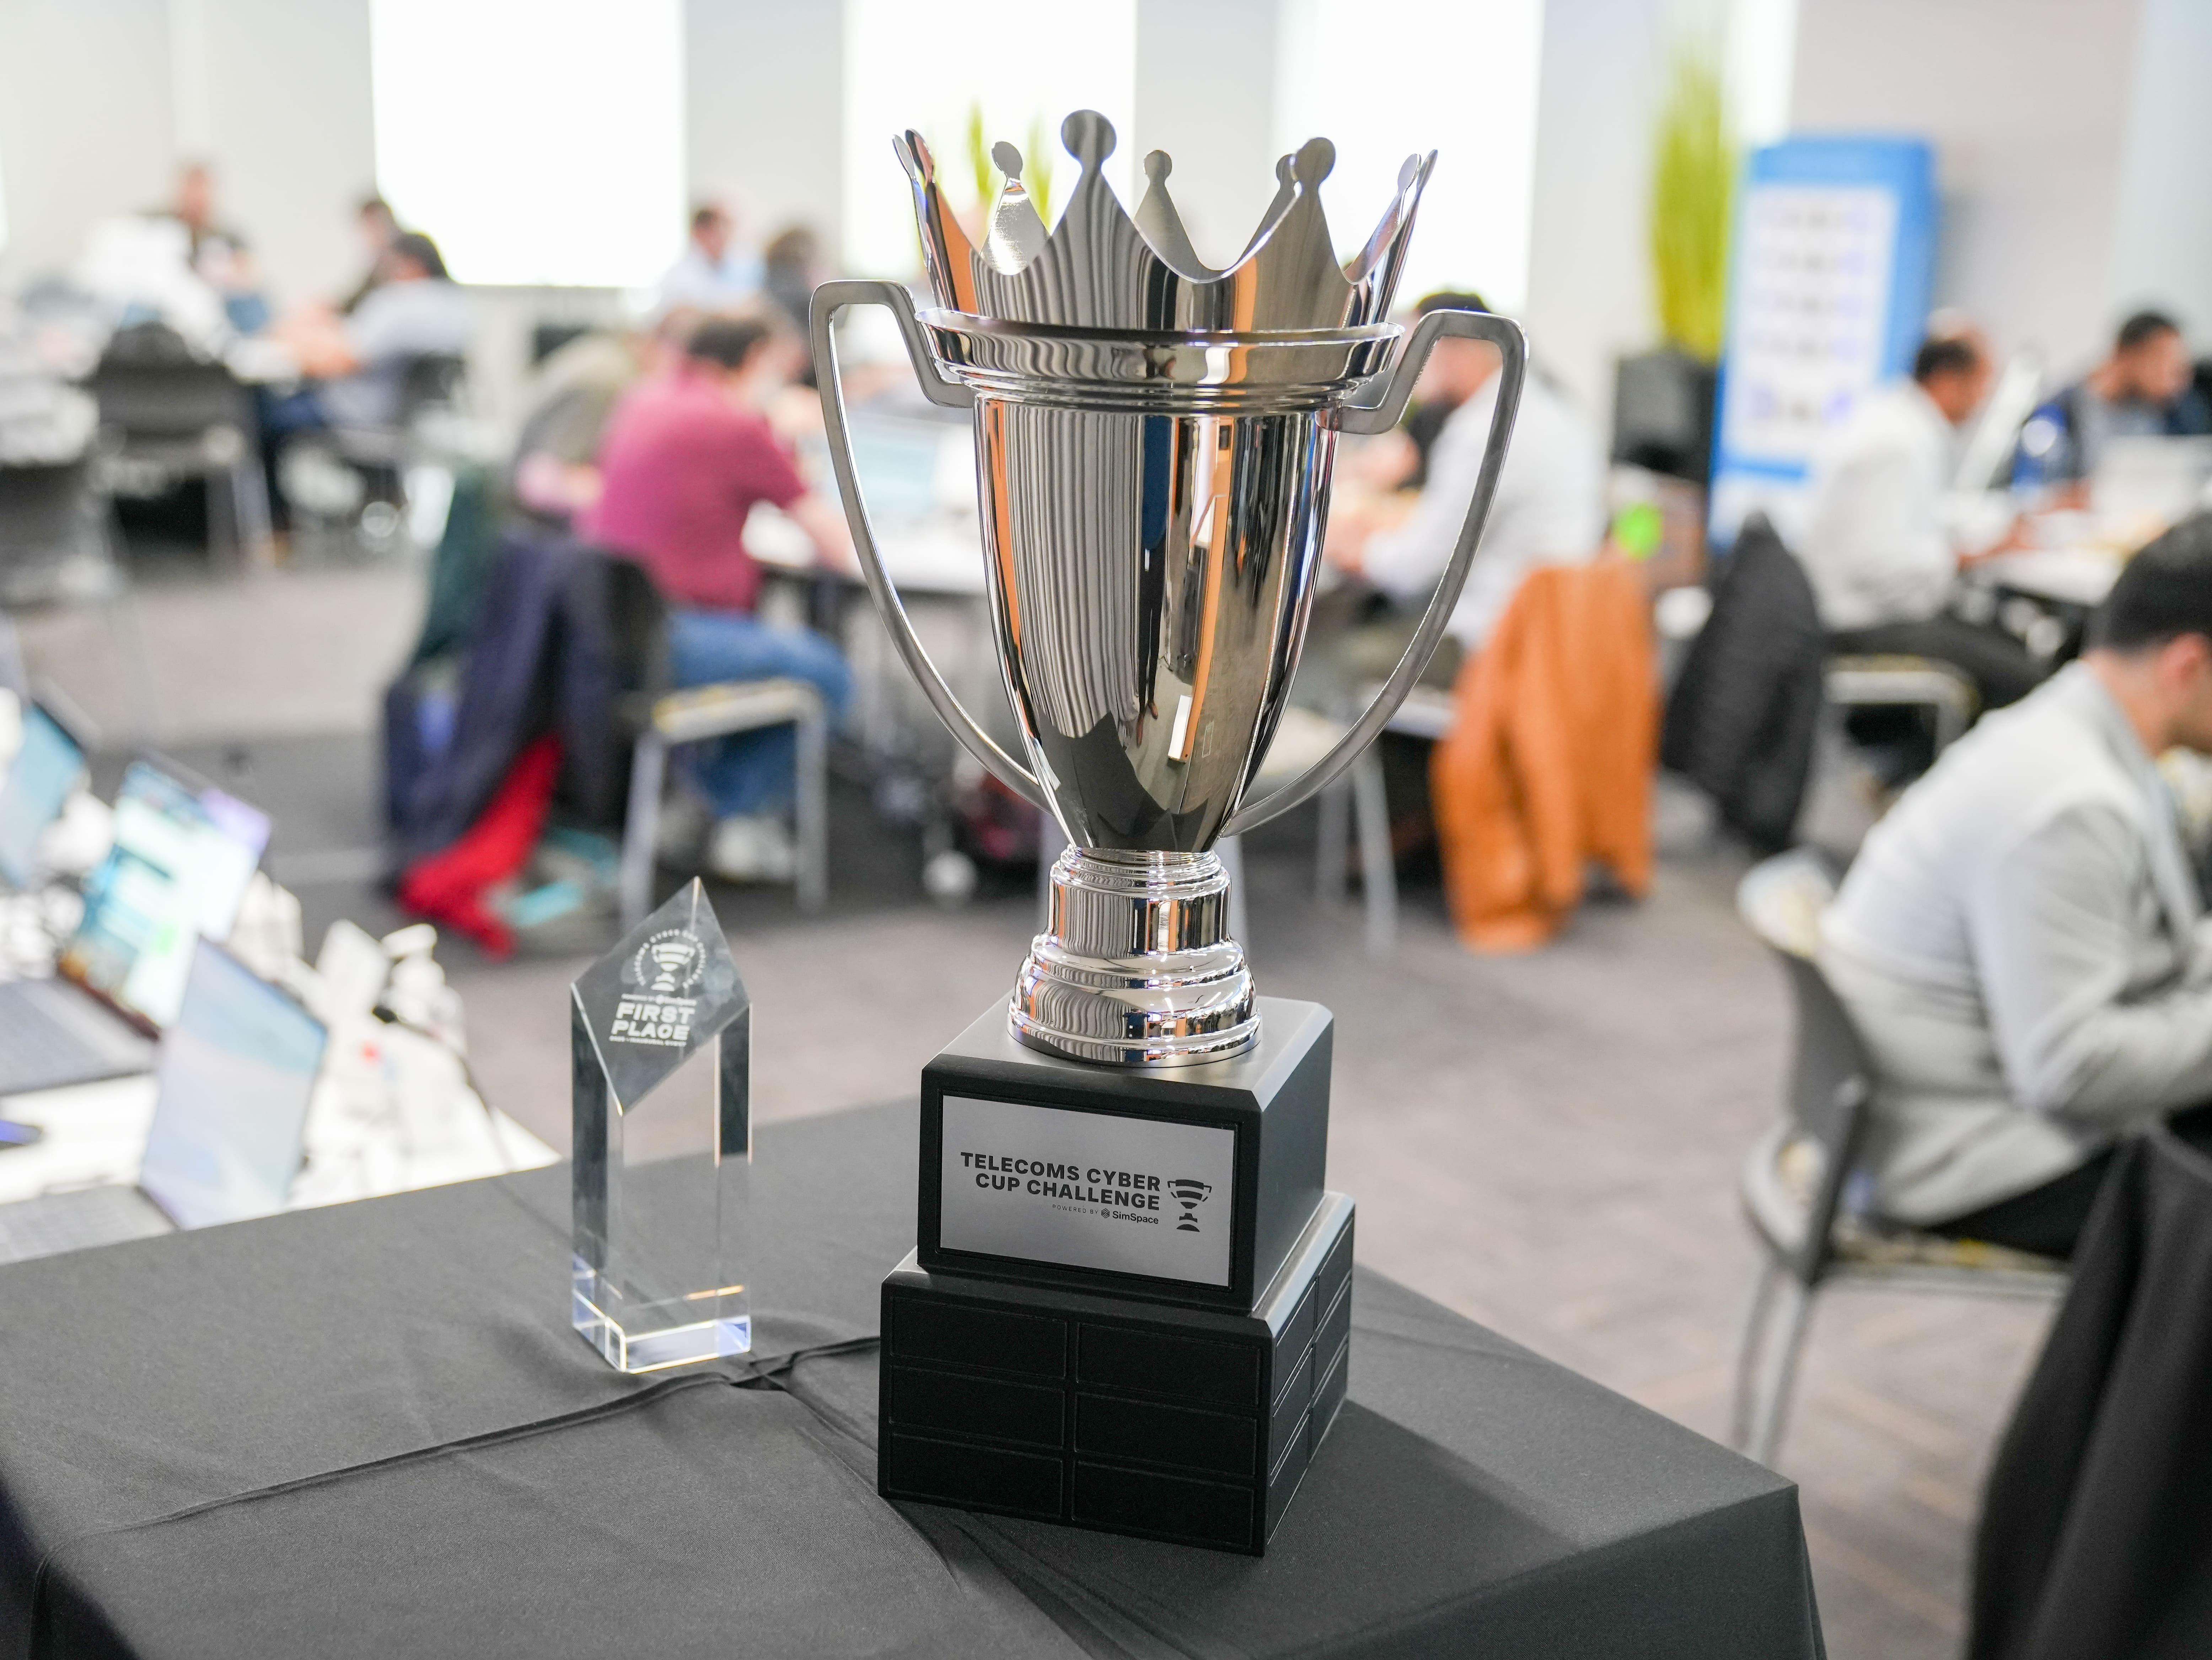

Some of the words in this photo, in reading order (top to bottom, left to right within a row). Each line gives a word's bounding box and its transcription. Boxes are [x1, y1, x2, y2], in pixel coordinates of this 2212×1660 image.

[616, 1001, 696, 1024] FIRST
[961, 1152, 1079, 1181] TELECOMS
[1087, 1168, 1160, 1191] CYBER
[976, 1173, 1020, 1191] CUP
[1027, 1180, 1160, 1211] CHALLENGE
[1052, 1204, 1086, 1213] POWERED
[1112, 1211, 1159, 1224] SimSpace
